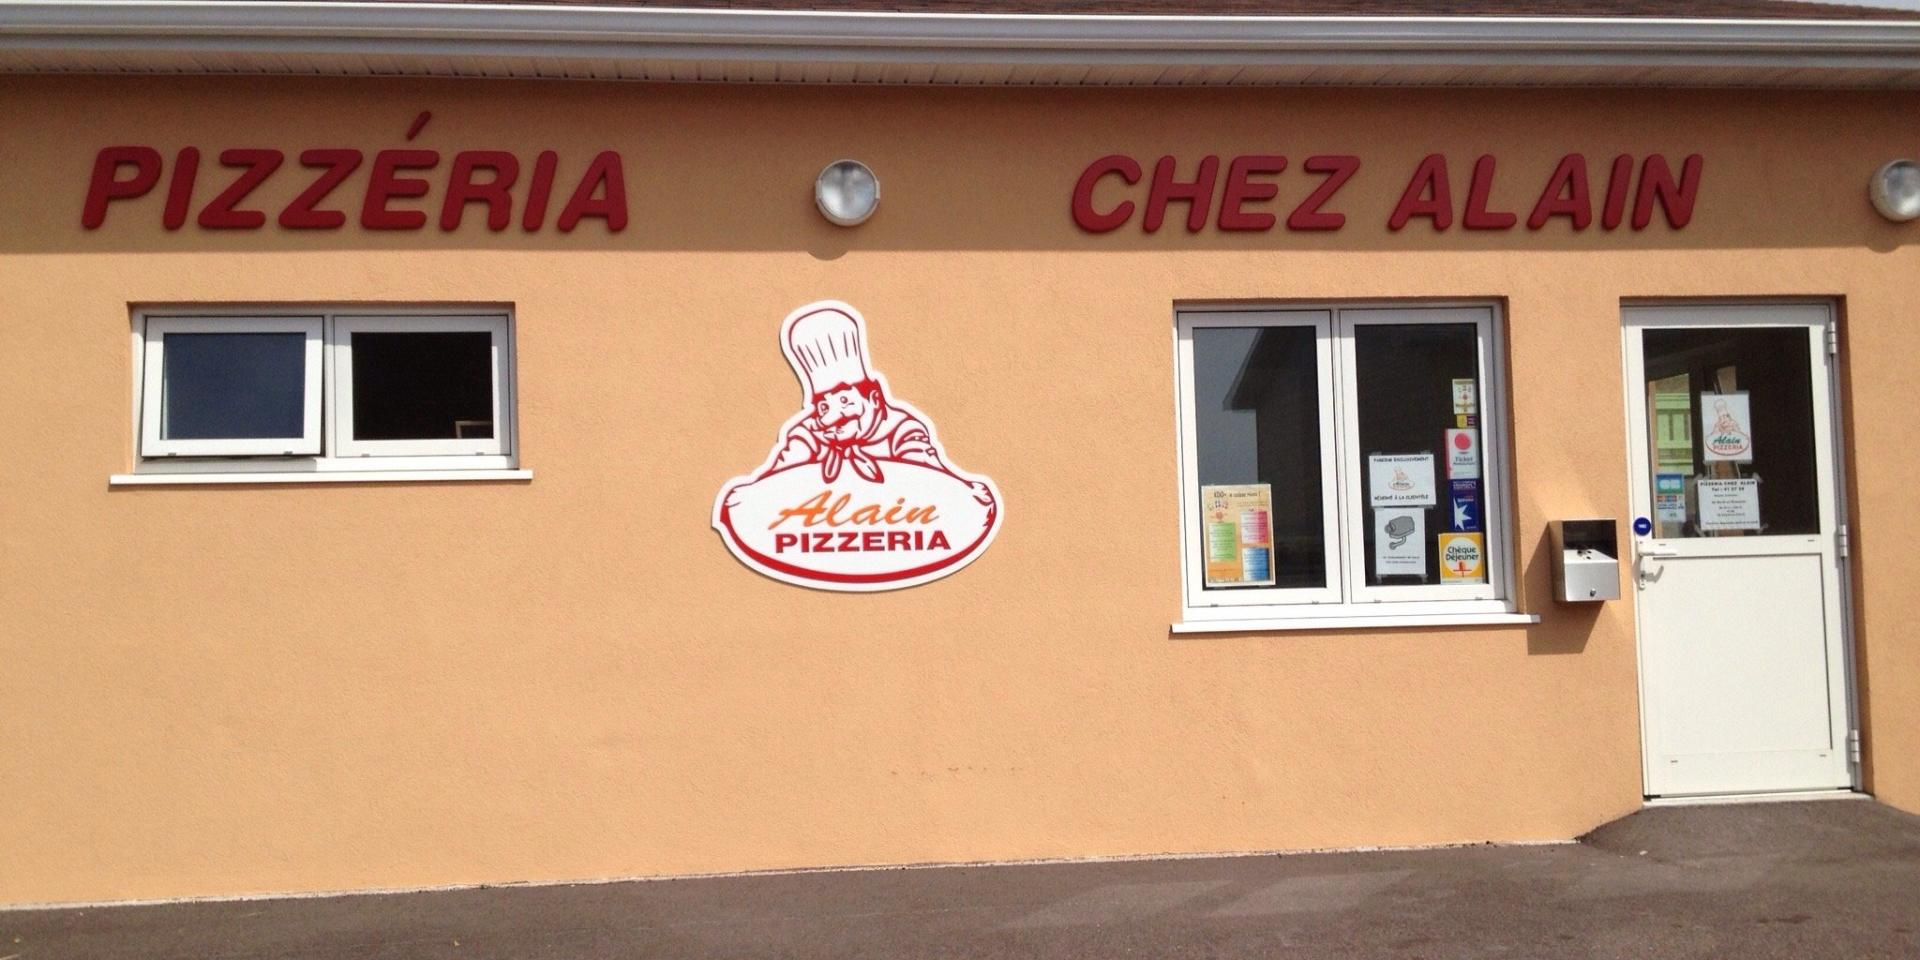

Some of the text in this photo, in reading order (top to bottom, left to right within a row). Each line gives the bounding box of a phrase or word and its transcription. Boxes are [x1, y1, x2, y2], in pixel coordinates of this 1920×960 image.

[82, 111, 629, 233] PIZZÉRIA
[1071, 153, 1704, 233] CHEZ ALAIN
[1712, 435, 1741, 444] Alain
[767, 490, 940, 530] Alain
[775, 530, 951, 553] PIZZERIA
[1447, 546, 1477, 556] Chèque
[1445, 553, 1480, 562] Déjeuner
